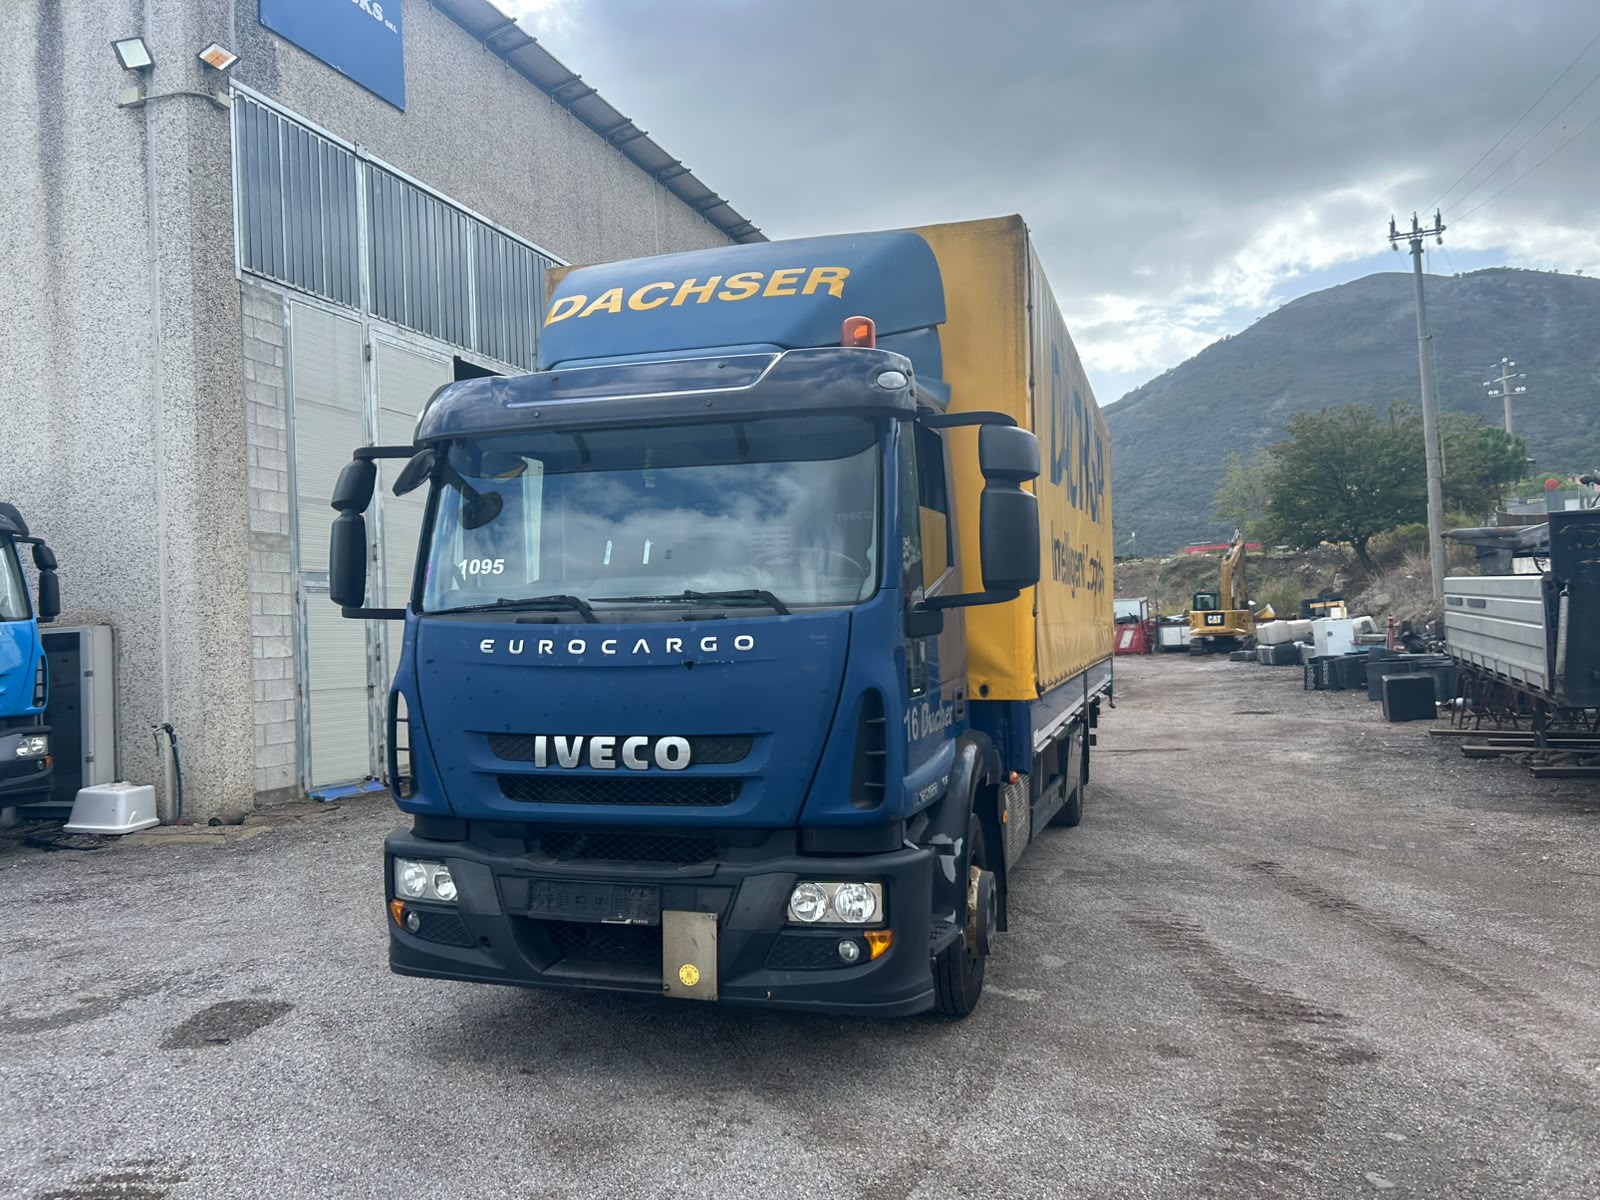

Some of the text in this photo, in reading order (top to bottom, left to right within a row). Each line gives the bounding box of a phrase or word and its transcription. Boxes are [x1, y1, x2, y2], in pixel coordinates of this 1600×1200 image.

[543, 266, 850, 328] DACHSER
[458, 558, 505, 581] 1095
[1207, 615, 1222, 624] CAT
[479, 635, 755, 655] EUROCARGO
[534, 735, 692, 771] IVECO
